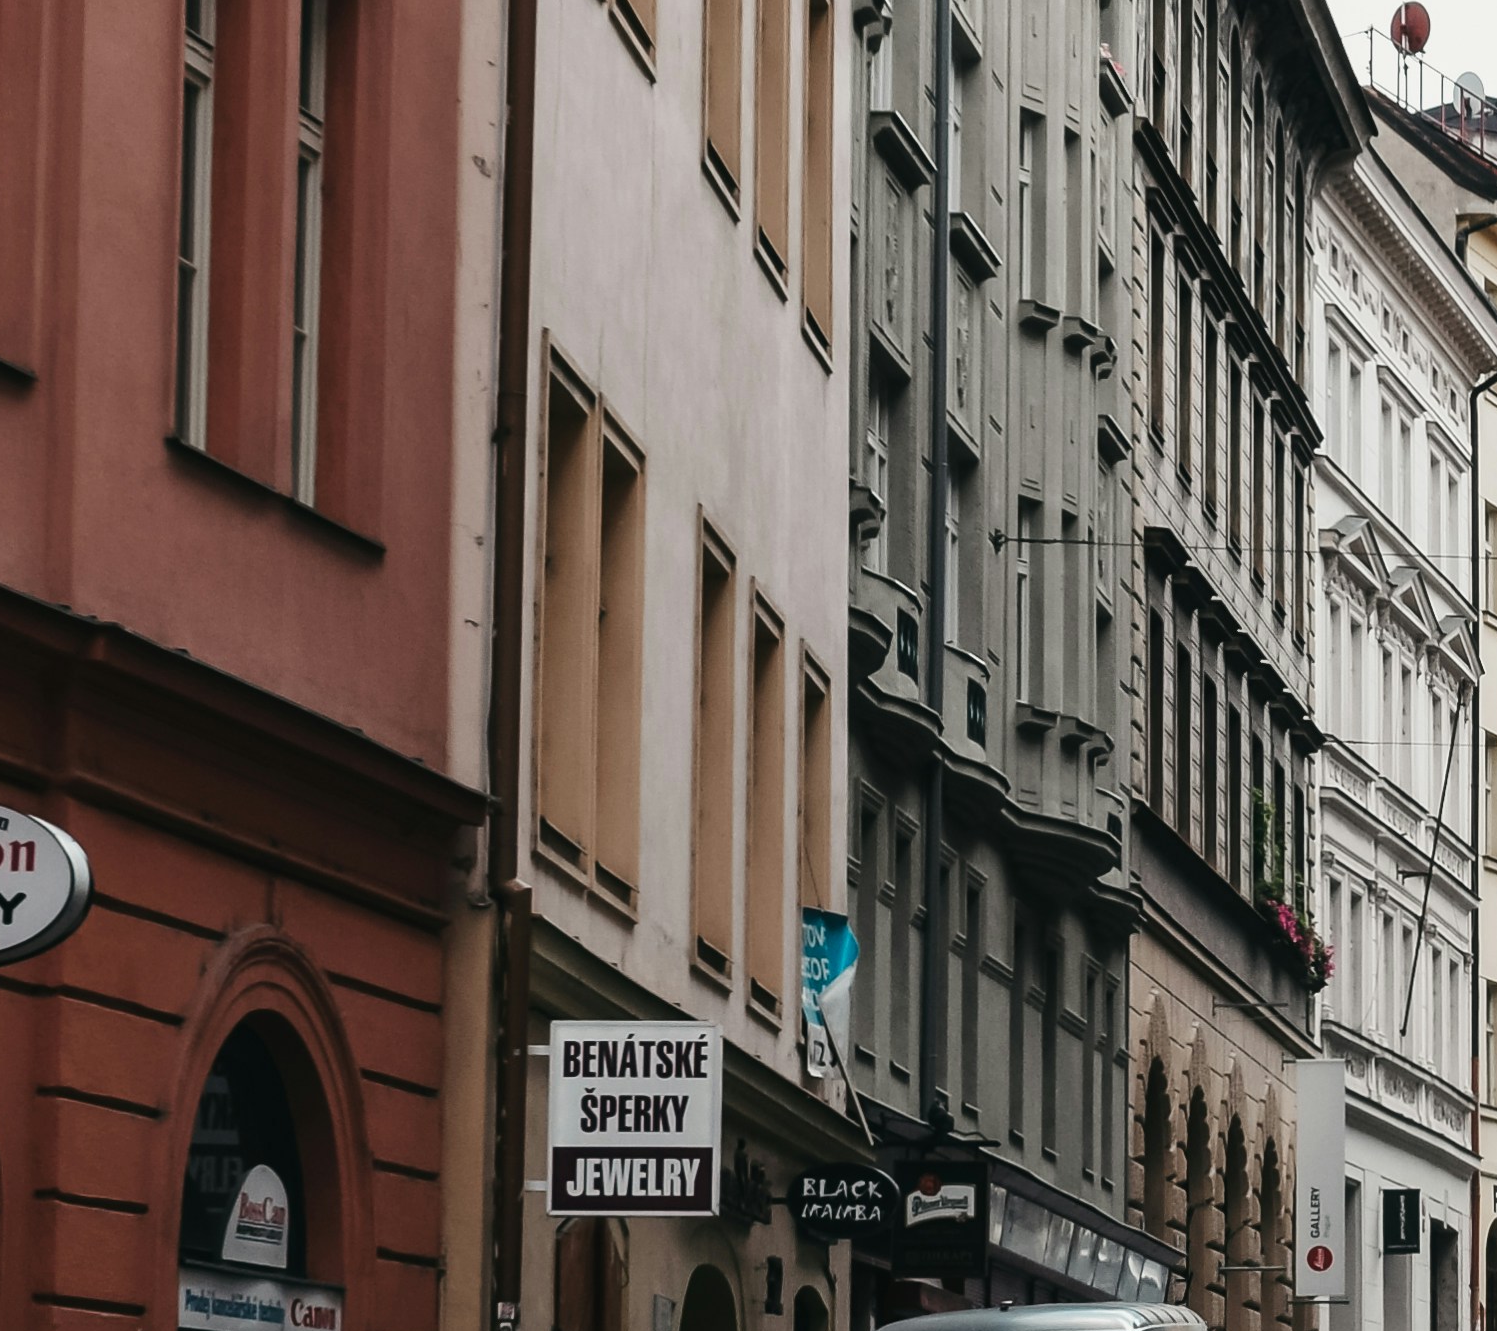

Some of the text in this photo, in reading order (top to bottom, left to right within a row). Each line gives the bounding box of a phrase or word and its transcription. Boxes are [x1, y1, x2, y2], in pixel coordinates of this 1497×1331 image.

[563, 1033, 708, 1078] BENÁTSKÉ
[580, 1087, 689, 1133] ŠPERKY
[566, 1158, 701, 1197] JEWELRY
[803, 1177, 882, 1199] BLACK
[801, 1203, 881, 1221] MAMBA
[1310, 1187, 1321, 1238] GALLERY
[291, 1298, 336, 1331] Canon
